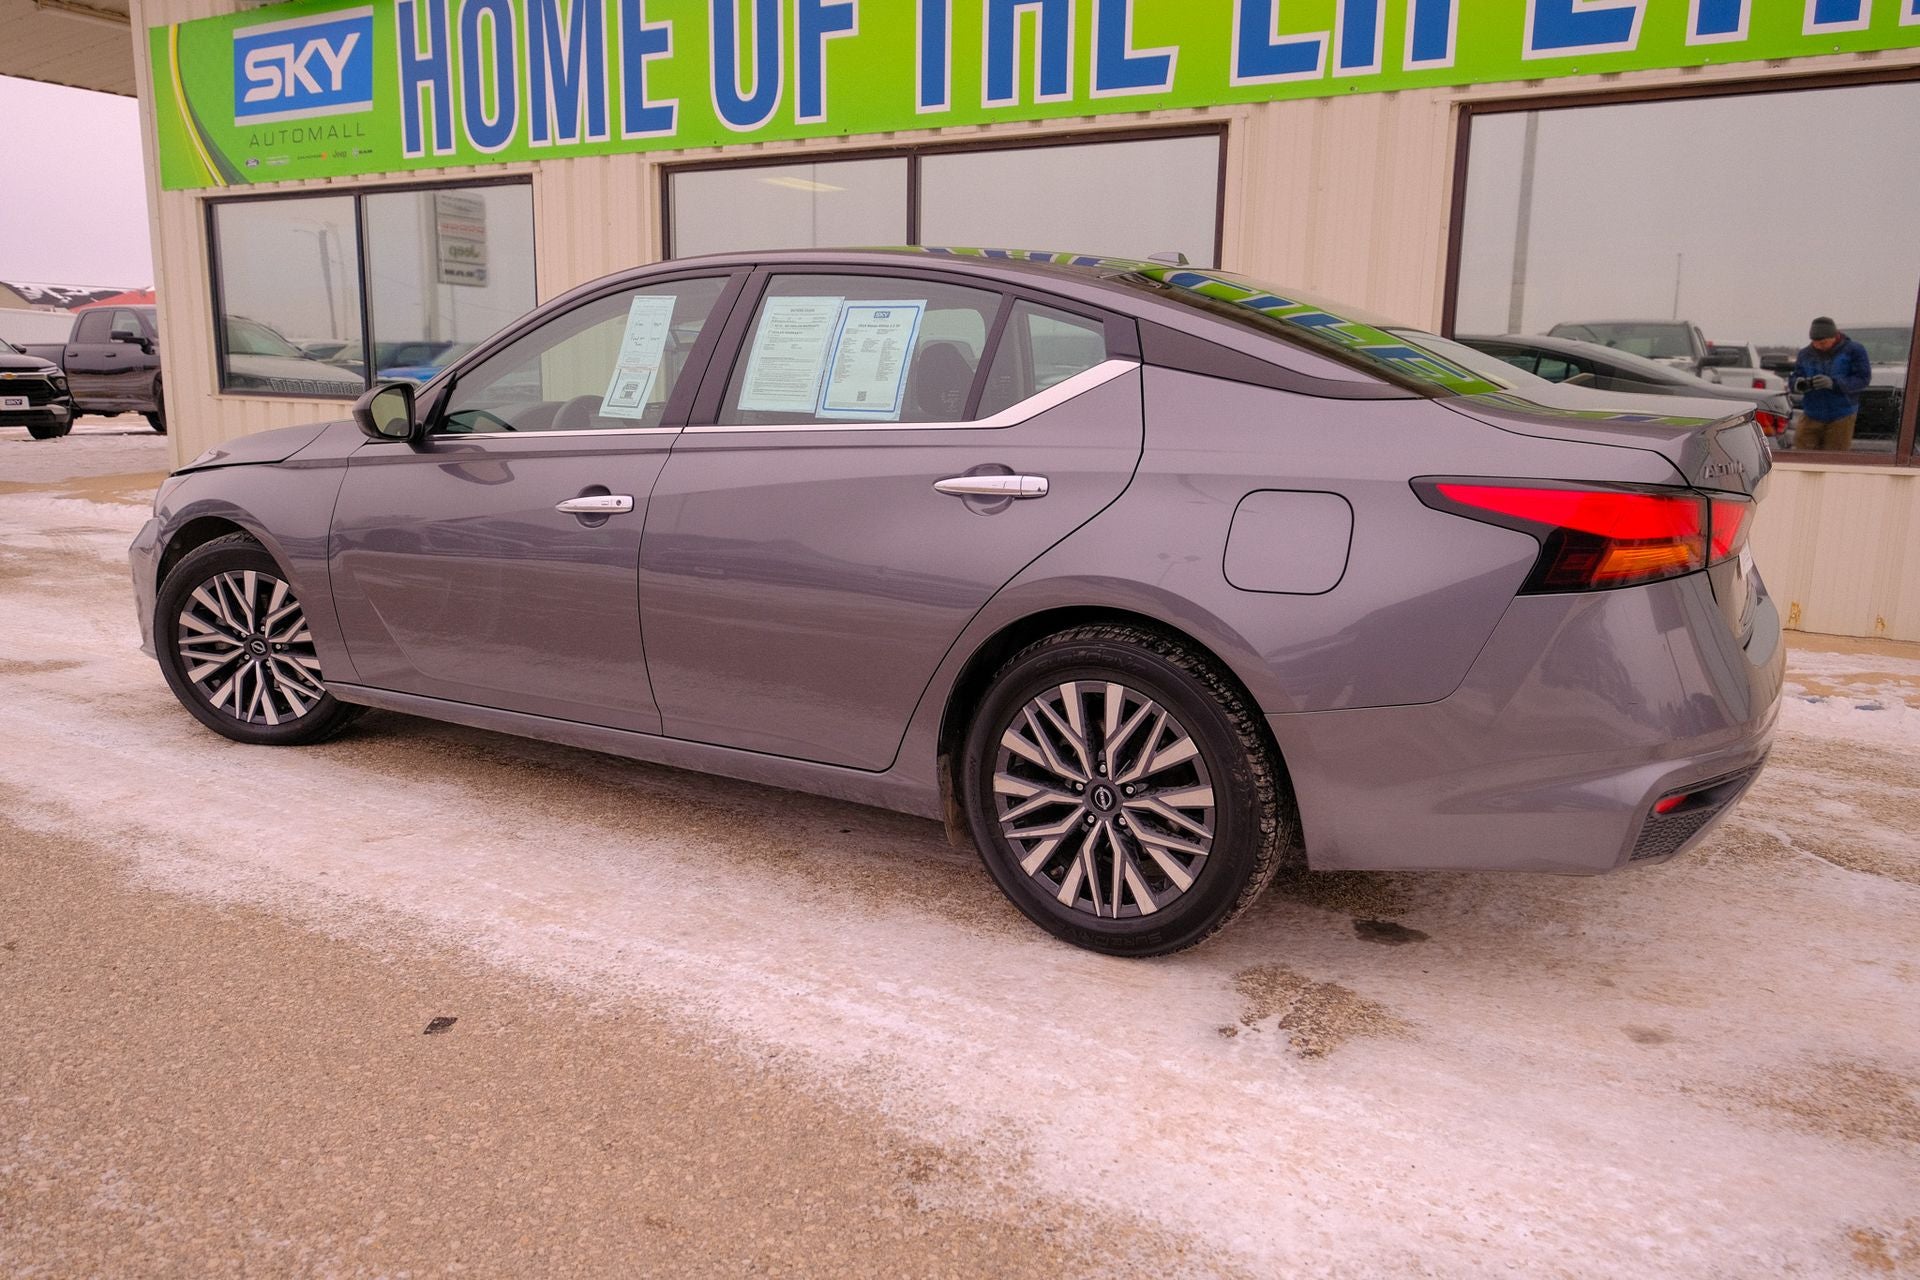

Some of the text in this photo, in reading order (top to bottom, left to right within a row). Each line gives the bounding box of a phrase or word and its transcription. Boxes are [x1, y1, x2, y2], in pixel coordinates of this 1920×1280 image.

[243, 32, 361, 102] SKY
[394, 0, 680, 159] HOME
[249, 120, 366, 148] AUTOMALL
